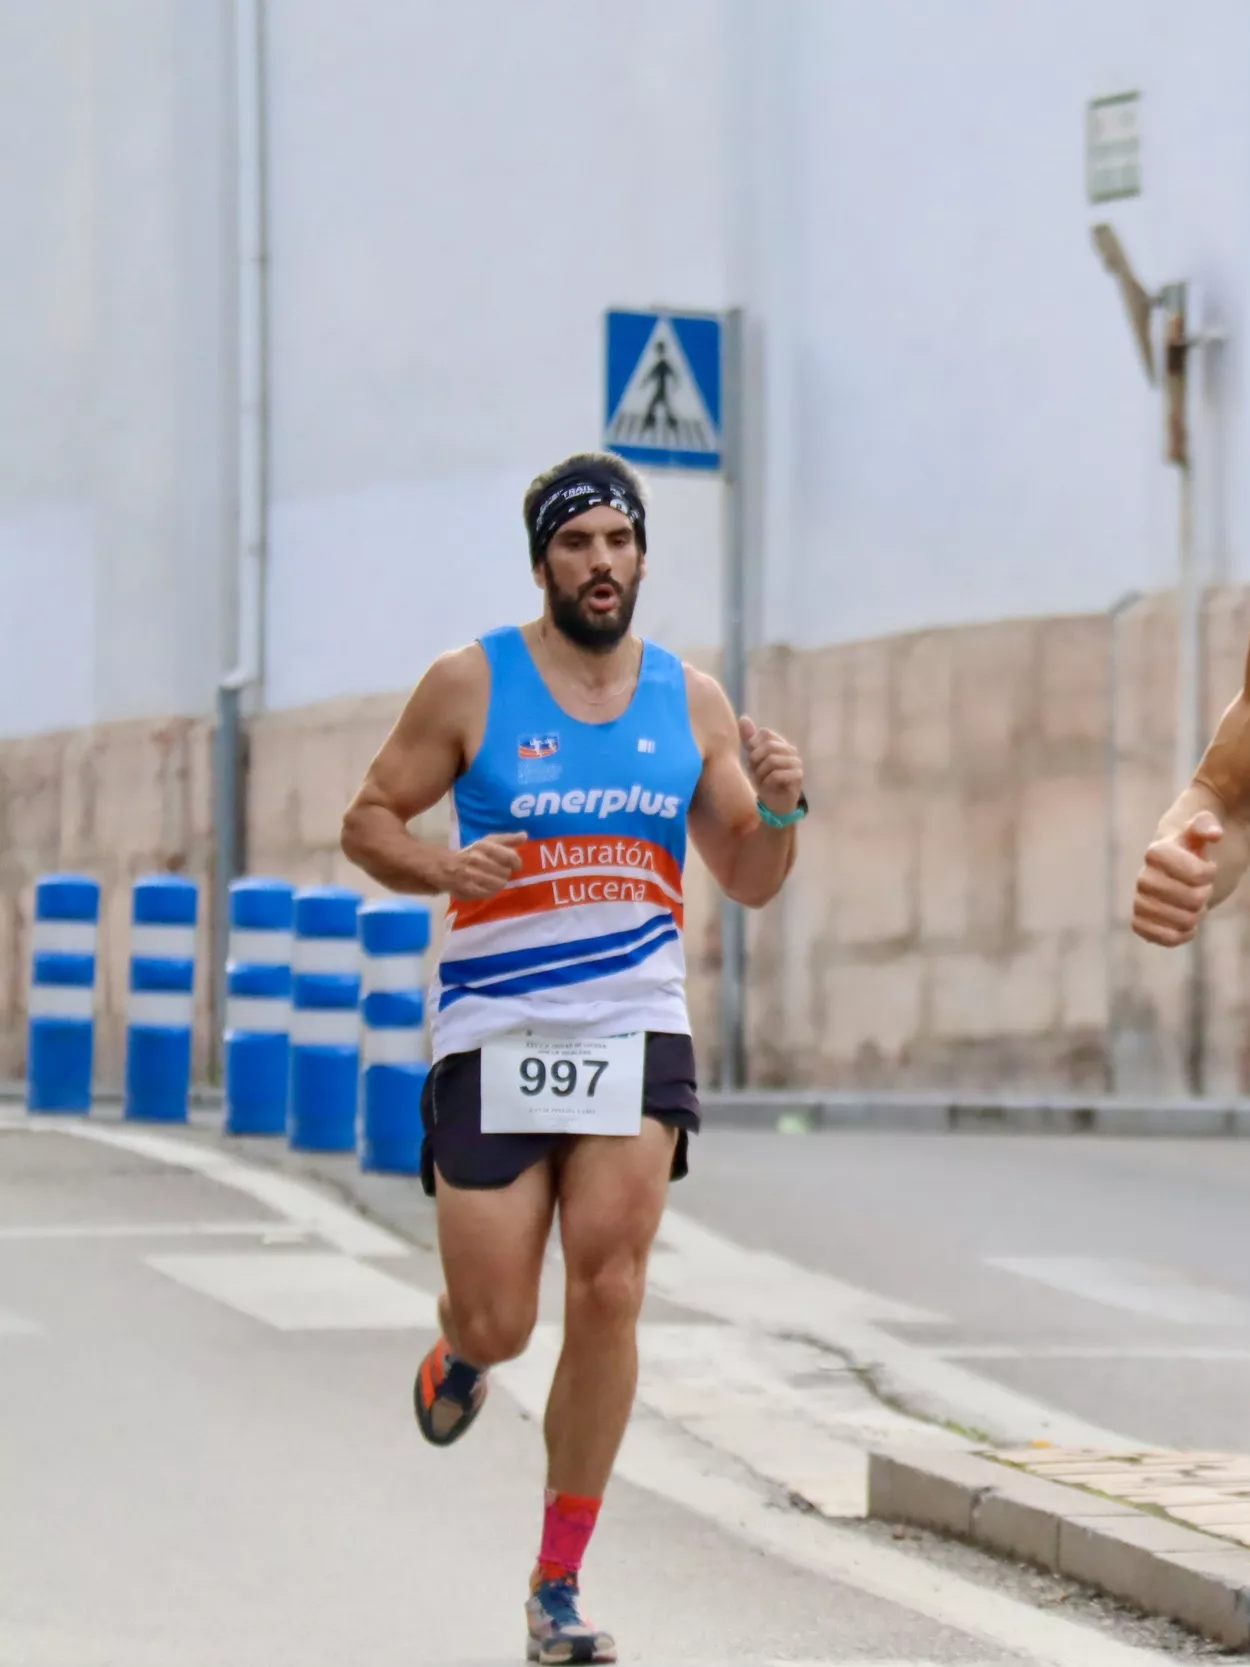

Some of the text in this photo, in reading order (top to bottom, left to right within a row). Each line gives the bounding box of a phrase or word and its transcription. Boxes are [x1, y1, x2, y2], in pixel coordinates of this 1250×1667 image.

[510, 785, 681, 819] enerplus
[539, 841, 655, 870] Maratón
[552, 879, 647, 905] Lucena
[519, 1057, 610, 1097] 997
